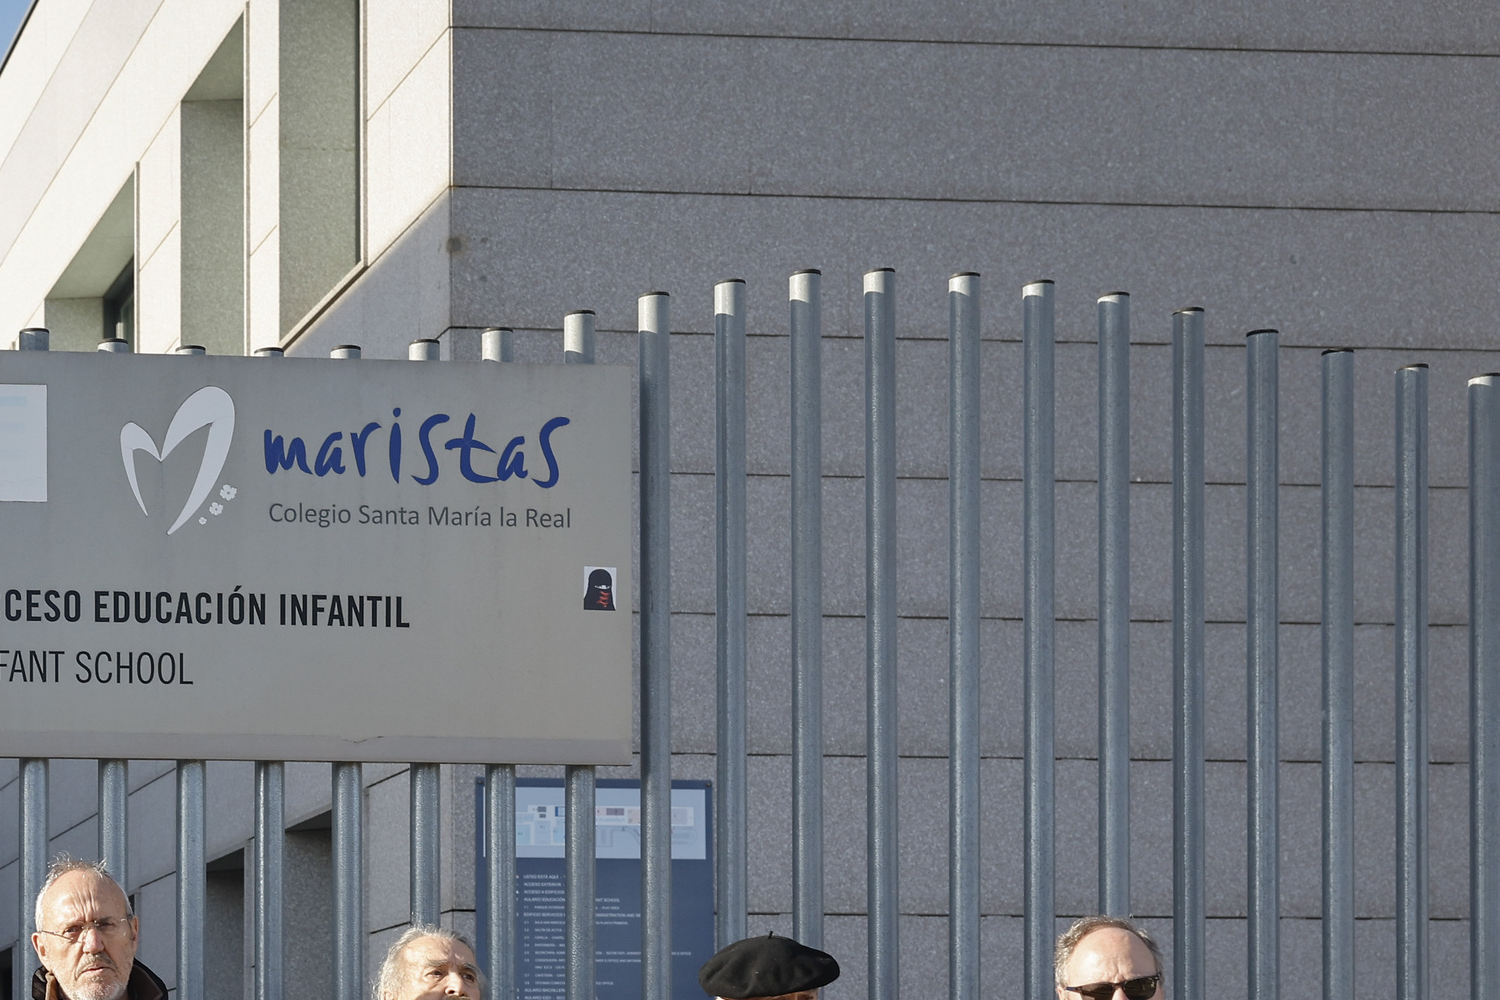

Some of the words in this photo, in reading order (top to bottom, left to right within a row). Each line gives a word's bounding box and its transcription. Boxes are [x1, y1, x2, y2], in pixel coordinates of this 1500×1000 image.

[265, 408, 569, 488] maristas
[269, 503, 350, 527] Colegio
[359, 505, 418, 525] Santa
[429, 506, 490, 526] María
[501, 507, 516, 526] la
[527, 508, 570, 528] Real
[95, 586, 265, 624] EDUCACIÓN
[280, 594, 409, 627] INFANTIL
[76, 651, 193, 684] SCHOOL
